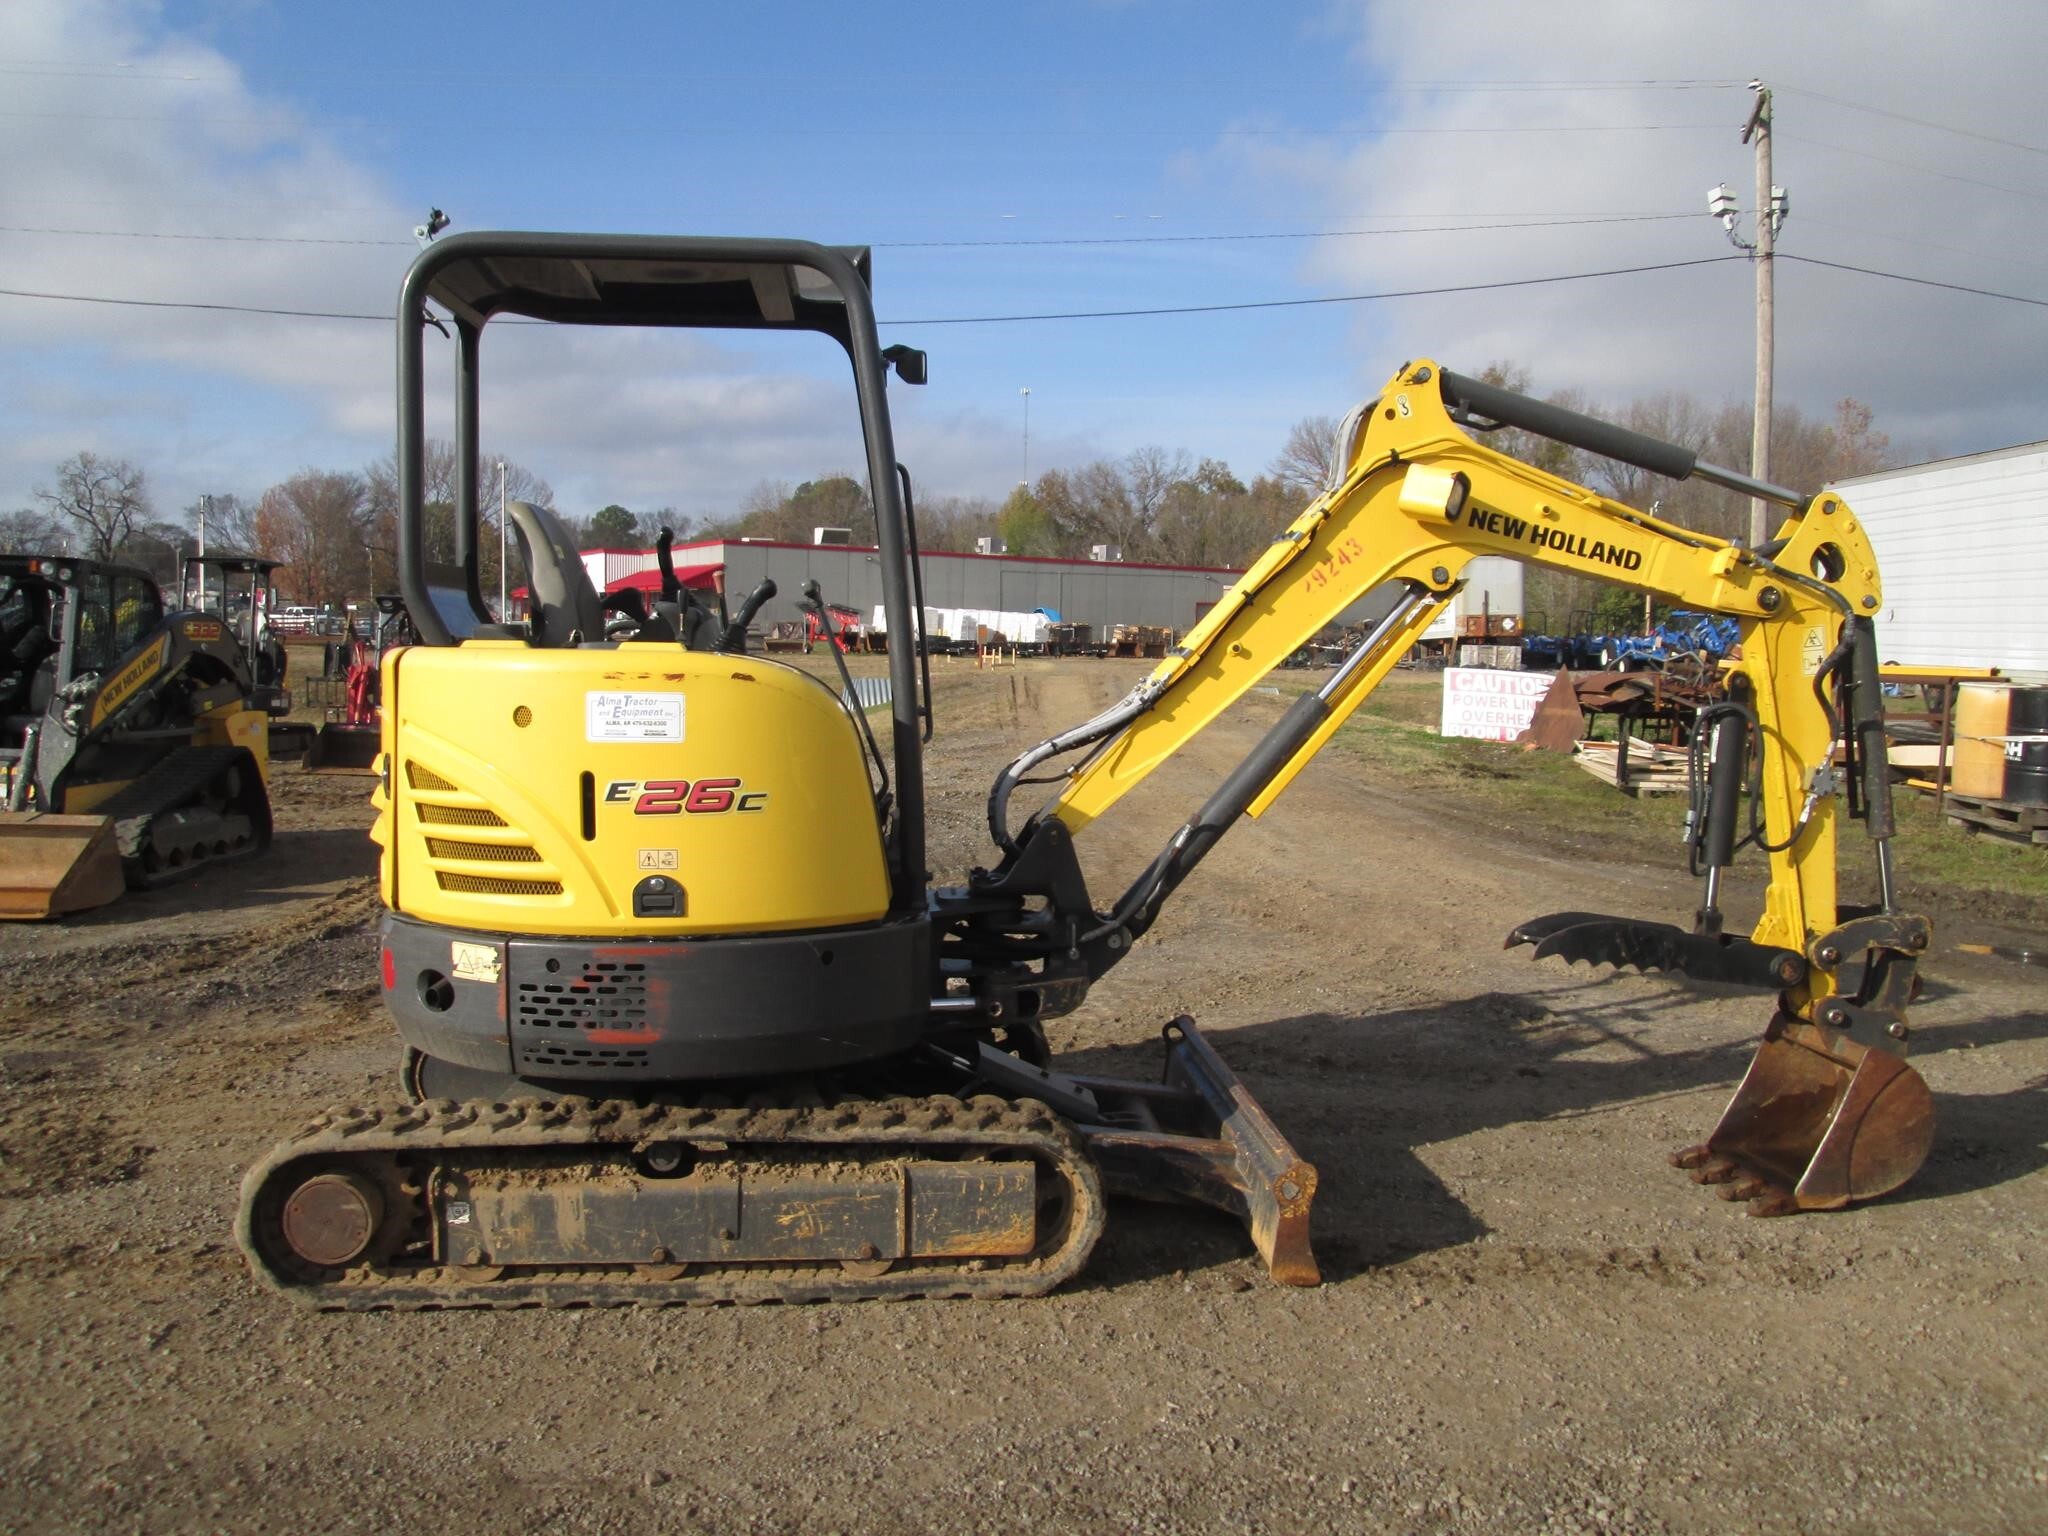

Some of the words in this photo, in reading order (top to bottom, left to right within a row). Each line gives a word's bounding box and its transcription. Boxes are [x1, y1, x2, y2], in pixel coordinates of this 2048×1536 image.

[1468, 507, 1527, 540] NEW
[1529, 524, 1642, 571] HOLLAND
[103, 682, 123, 706] NEW
[123, 650, 159, 689] HOLLAND
[597, 695, 621, 707] Alma
[623, 695, 658, 707] Tractor
[1453, 694, 1508, 709] POWER
[612, 706, 664, 718] Equipment
[1448, 723, 1501, 740] BOOM
